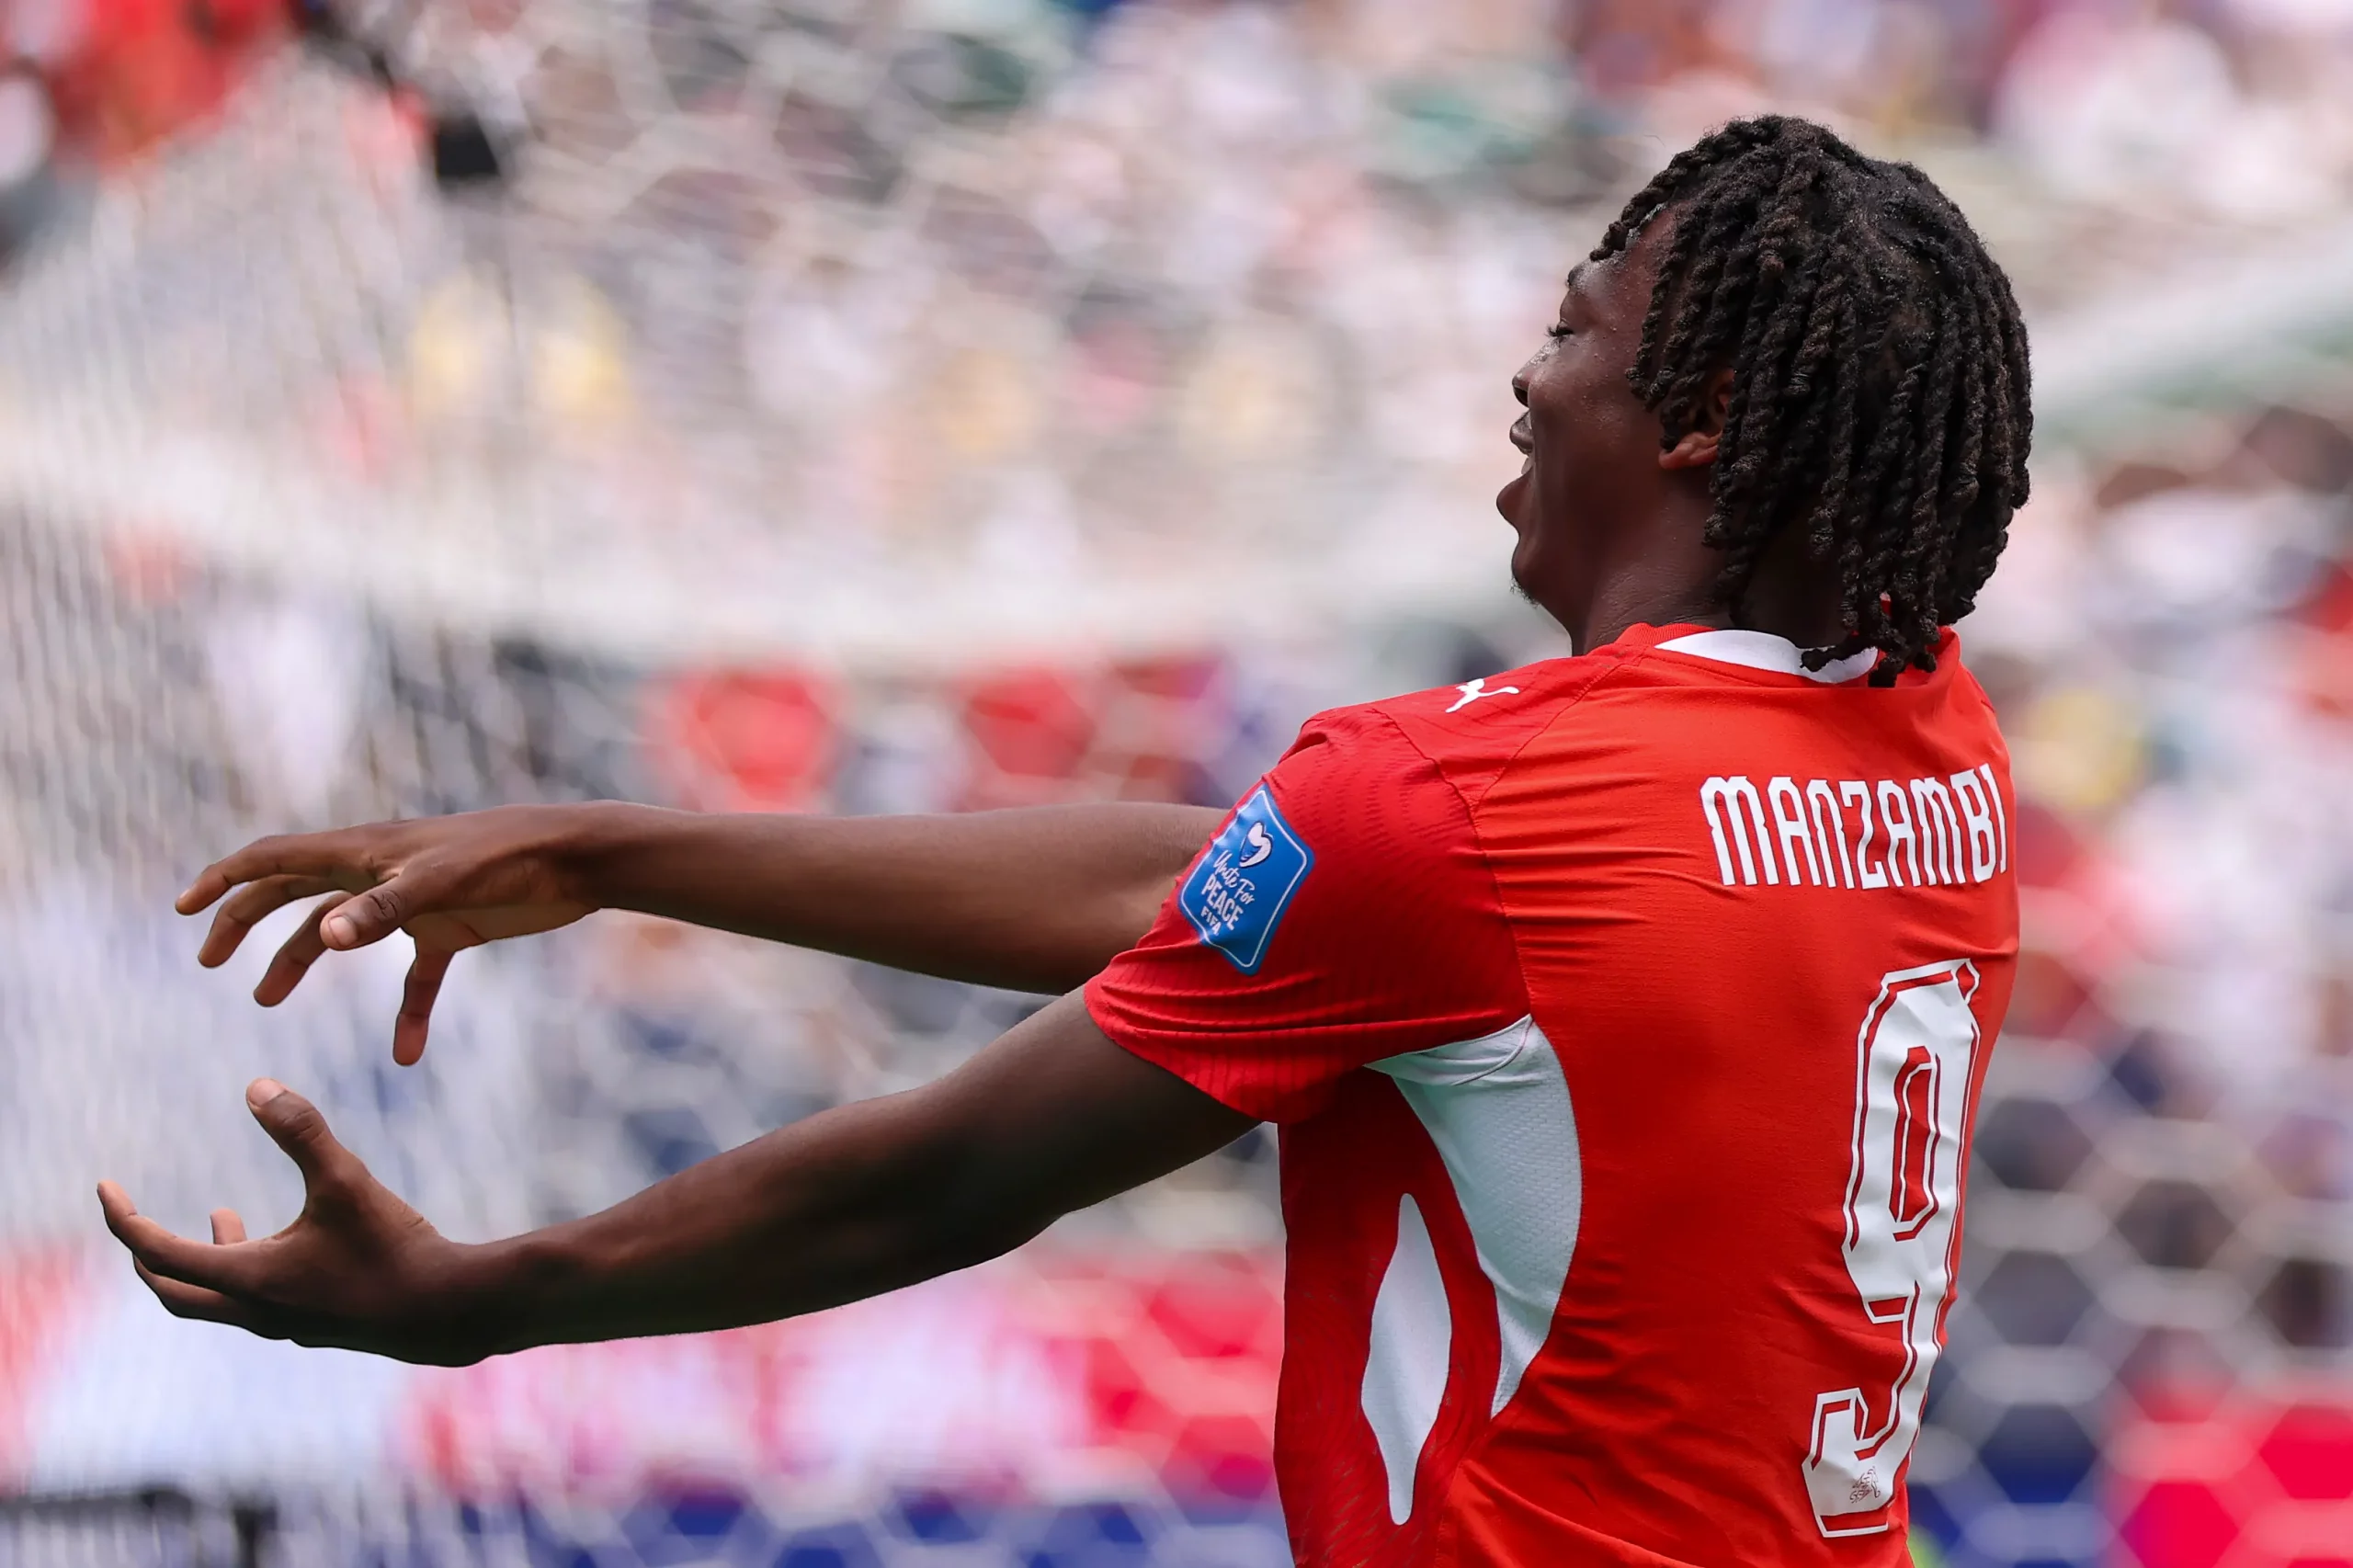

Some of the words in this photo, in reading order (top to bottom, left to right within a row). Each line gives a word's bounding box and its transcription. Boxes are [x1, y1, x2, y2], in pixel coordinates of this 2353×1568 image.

[1699, 763, 2007, 890] MANZAMBI
[1200, 874, 1244, 930] PEACE
[1213, 850, 1240, 888] Unite
[1234, 878, 1255, 905] For
[1200, 905, 1222, 936] FIFA
[1802, 958, 1981, 1538] 9
